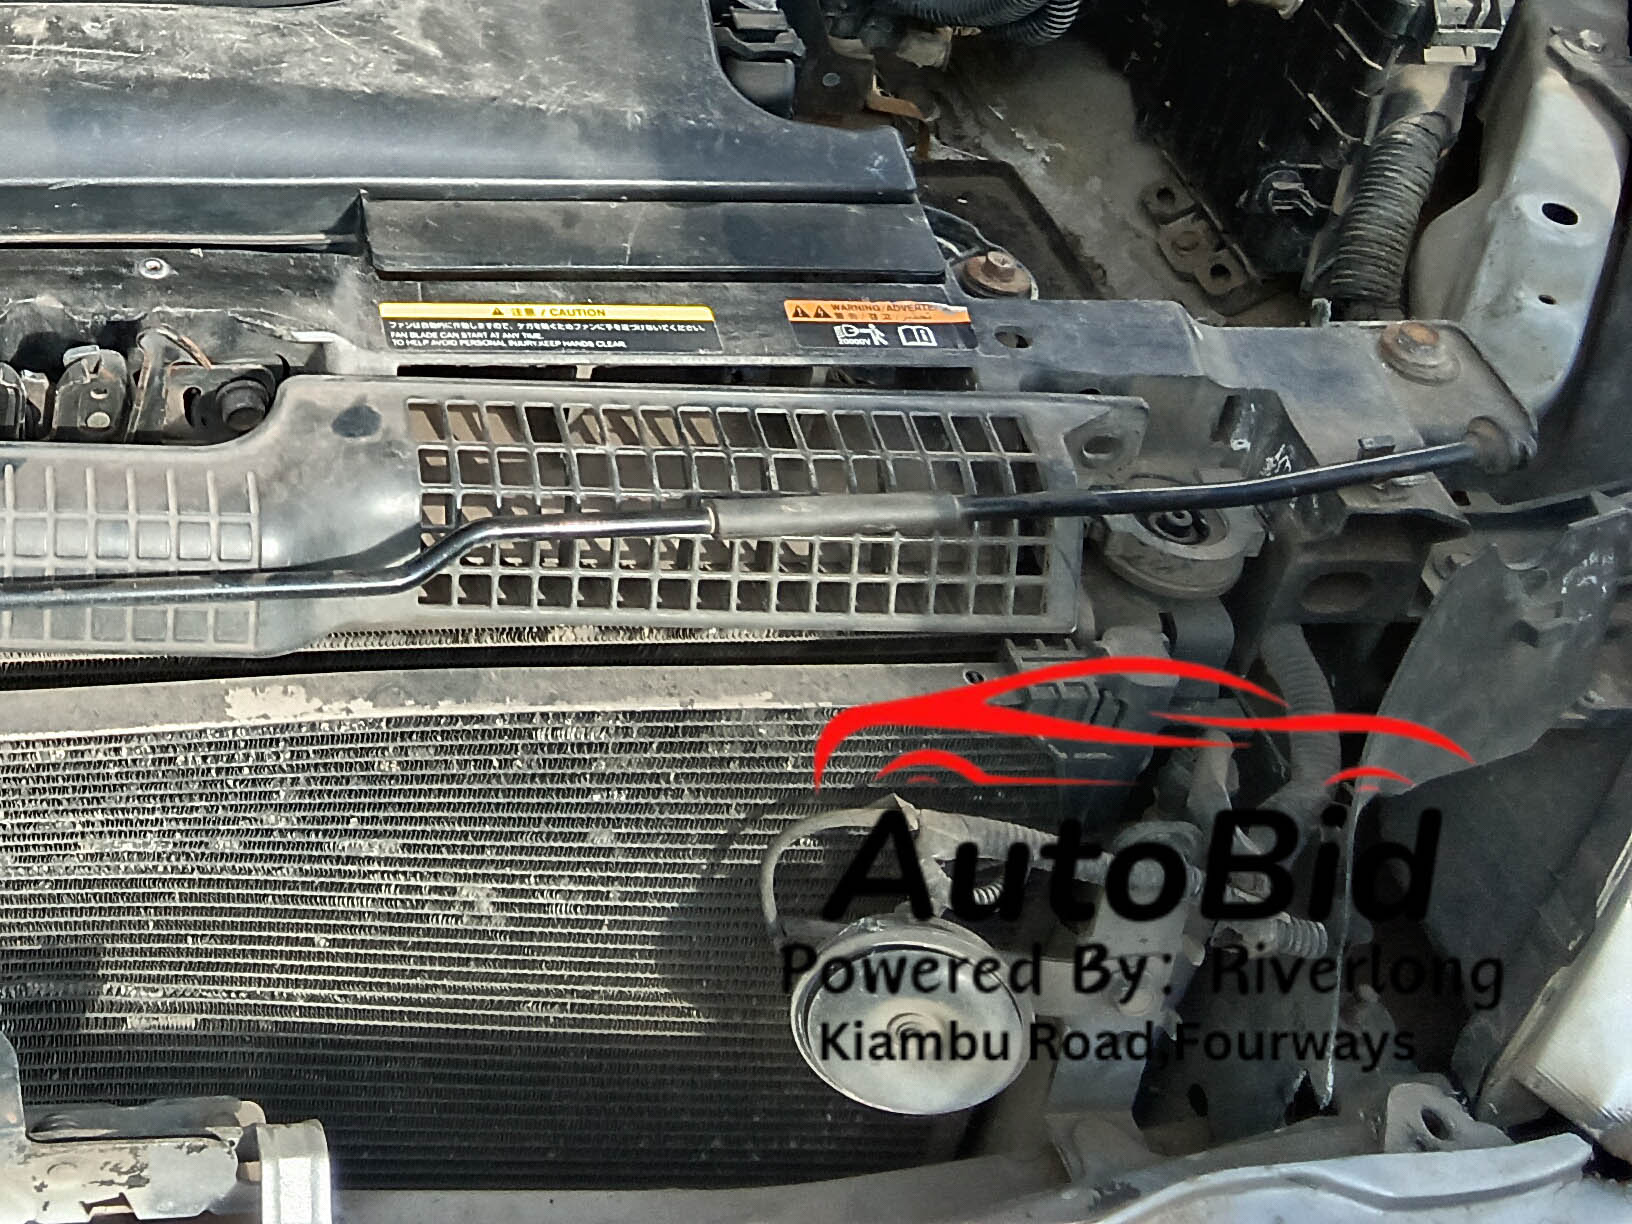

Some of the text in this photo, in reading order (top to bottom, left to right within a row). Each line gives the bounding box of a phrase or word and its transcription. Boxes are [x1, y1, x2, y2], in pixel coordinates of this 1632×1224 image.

[831, 303, 881, 312] WARNING
[549, 308, 606, 317] CAUTION
[409, 331, 438, 339] BLADE
[439, 331, 460, 339] CAN
[460, 331, 487, 339] START
[489, 331, 500, 339] AT
[391, 338, 405, 346] TO
[405, 339, 429, 347] HELP
[430, 339, 458, 347] AVOID
[458, 339, 507, 347] PERSONAL
[562, 340, 595, 348] HANDS
